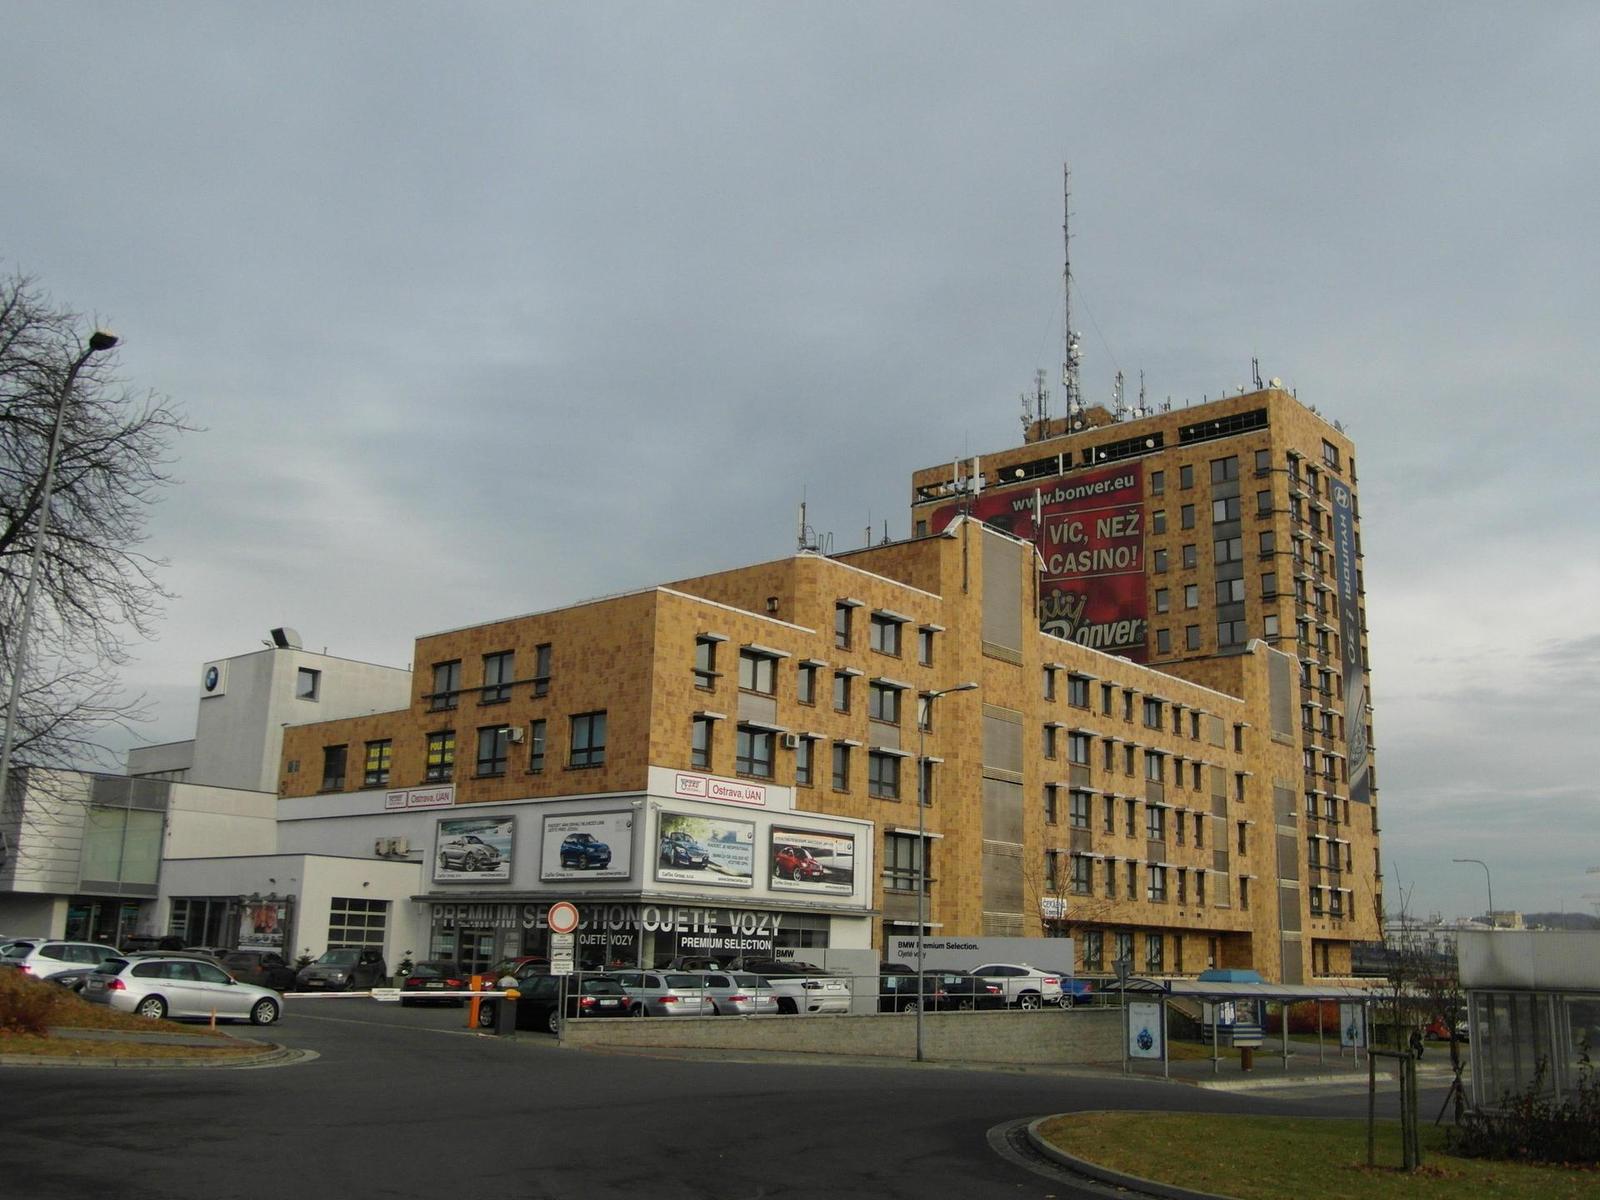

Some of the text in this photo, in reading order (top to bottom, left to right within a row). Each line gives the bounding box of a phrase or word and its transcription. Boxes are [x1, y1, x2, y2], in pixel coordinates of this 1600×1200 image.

[1013, 475, 1135, 511] www.bonver.eu
[1050, 509, 1140, 545] VÍC, NEŽ
[1049, 546, 1138, 575] CASINO!
[1340, 514, 1351, 601] HYUNDAI
[713, 784, 744, 799] Ostrava,
[432, 904, 640, 930] PREMIUM SECTION
[729, 910, 783, 936] VOZY
[610, 934, 634, 946] VOZY
[681, 937, 772, 950] PREMIUM SELECTION
[946, 942, 979, 950] Selection.
[776, 949, 795, 958] BMW
